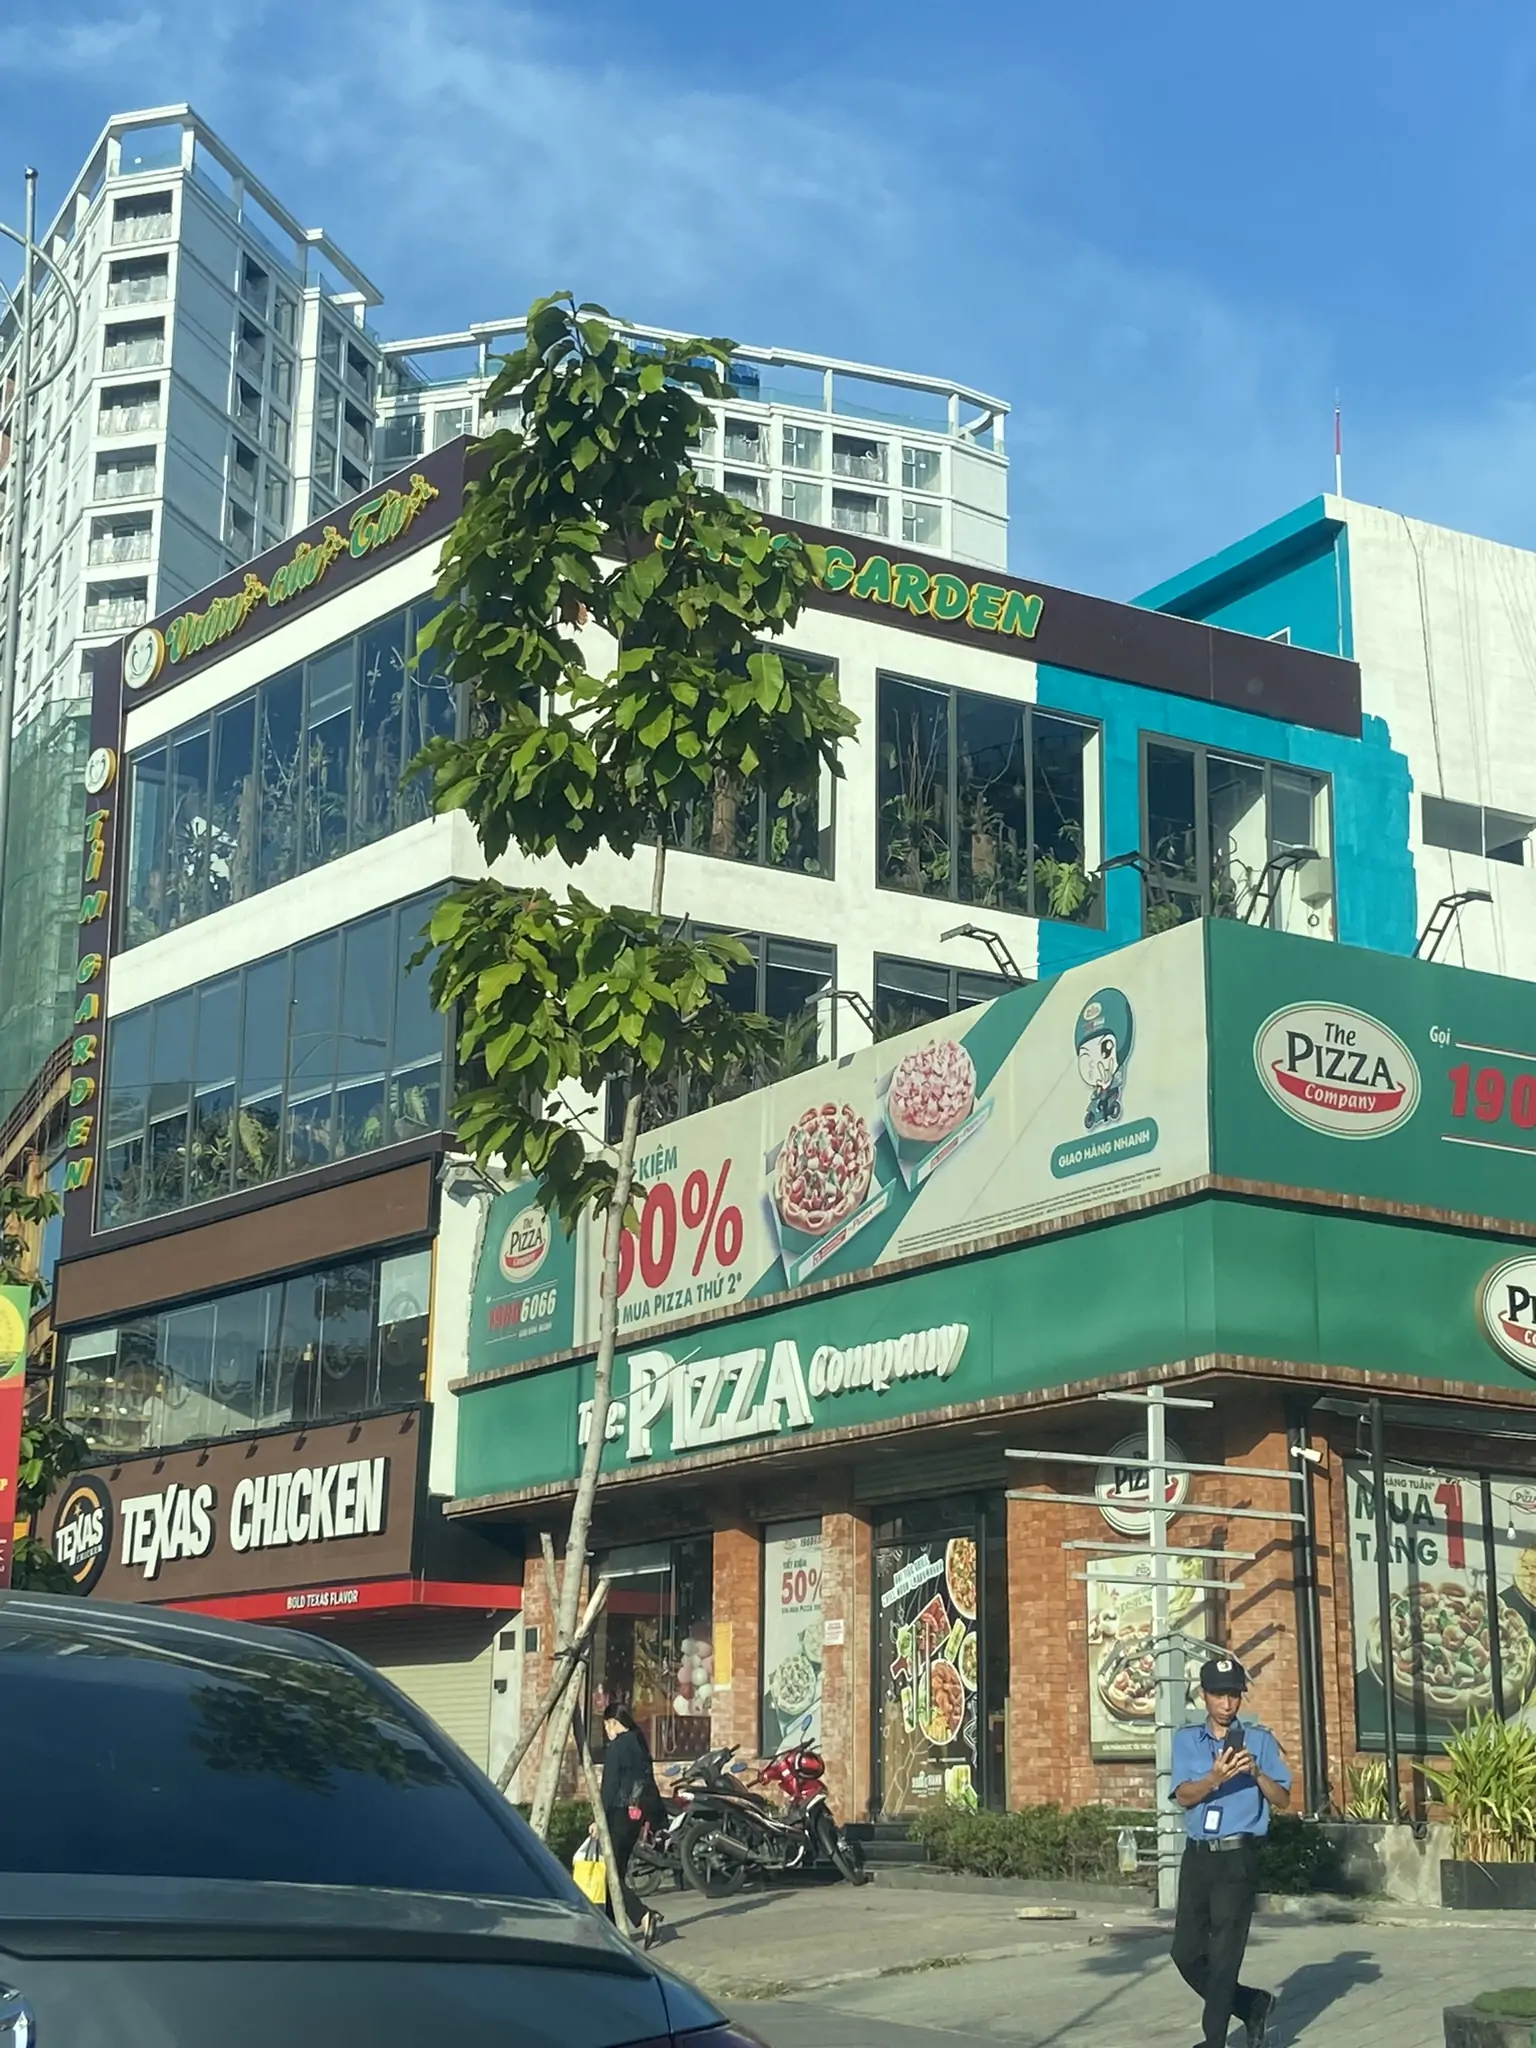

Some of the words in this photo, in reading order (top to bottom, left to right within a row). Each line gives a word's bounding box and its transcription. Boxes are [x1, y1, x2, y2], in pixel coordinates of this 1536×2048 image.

[812, 545, 1044, 639] GARDEN
[1324, 1022, 1357, 1047] The
[1429, 1025, 1451, 1048] Gọi
[63, 952, 103, 1192] GARDEN
[1286, 1030, 1396, 1091] PIZZA
[1304, 1083, 1377, 1111] Company
[639, 1144, 678, 1181] KIỆM
[1058, 1150, 1083, 1168] GIAO
[1084, 1143, 1112, 1159] HÀNG
[1113, 1129, 1150, 1151] NHANH
[509, 1227, 544, 1255] PIZZA
[623, 1304, 650, 1324] MUA
[654, 1287, 693, 1316] PIZZA
[697, 1272, 724, 1303] THỨ
[578, 1399, 627, 1445] Te
[626, 1340, 813, 1459] PIZZA
[809, 1323, 969, 1397] Company
[1114, 1466, 1169, 1494] PIZ
[121, 1483, 213, 1578] TEXAS
[230, 1457, 386, 1552] CHICKEN
[1434, 1482, 1467, 1569] 1
[56, 1508, 104, 1566] TEXAS
[1355, 1532, 1438, 1566] TNG
[287, 1595, 306, 1610] BOLD
[307, 1592, 329, 1607] TEXAS
[330, 1589, 359, 1605] FLAVOR
[781, 1568, 823, 1605] 50%
